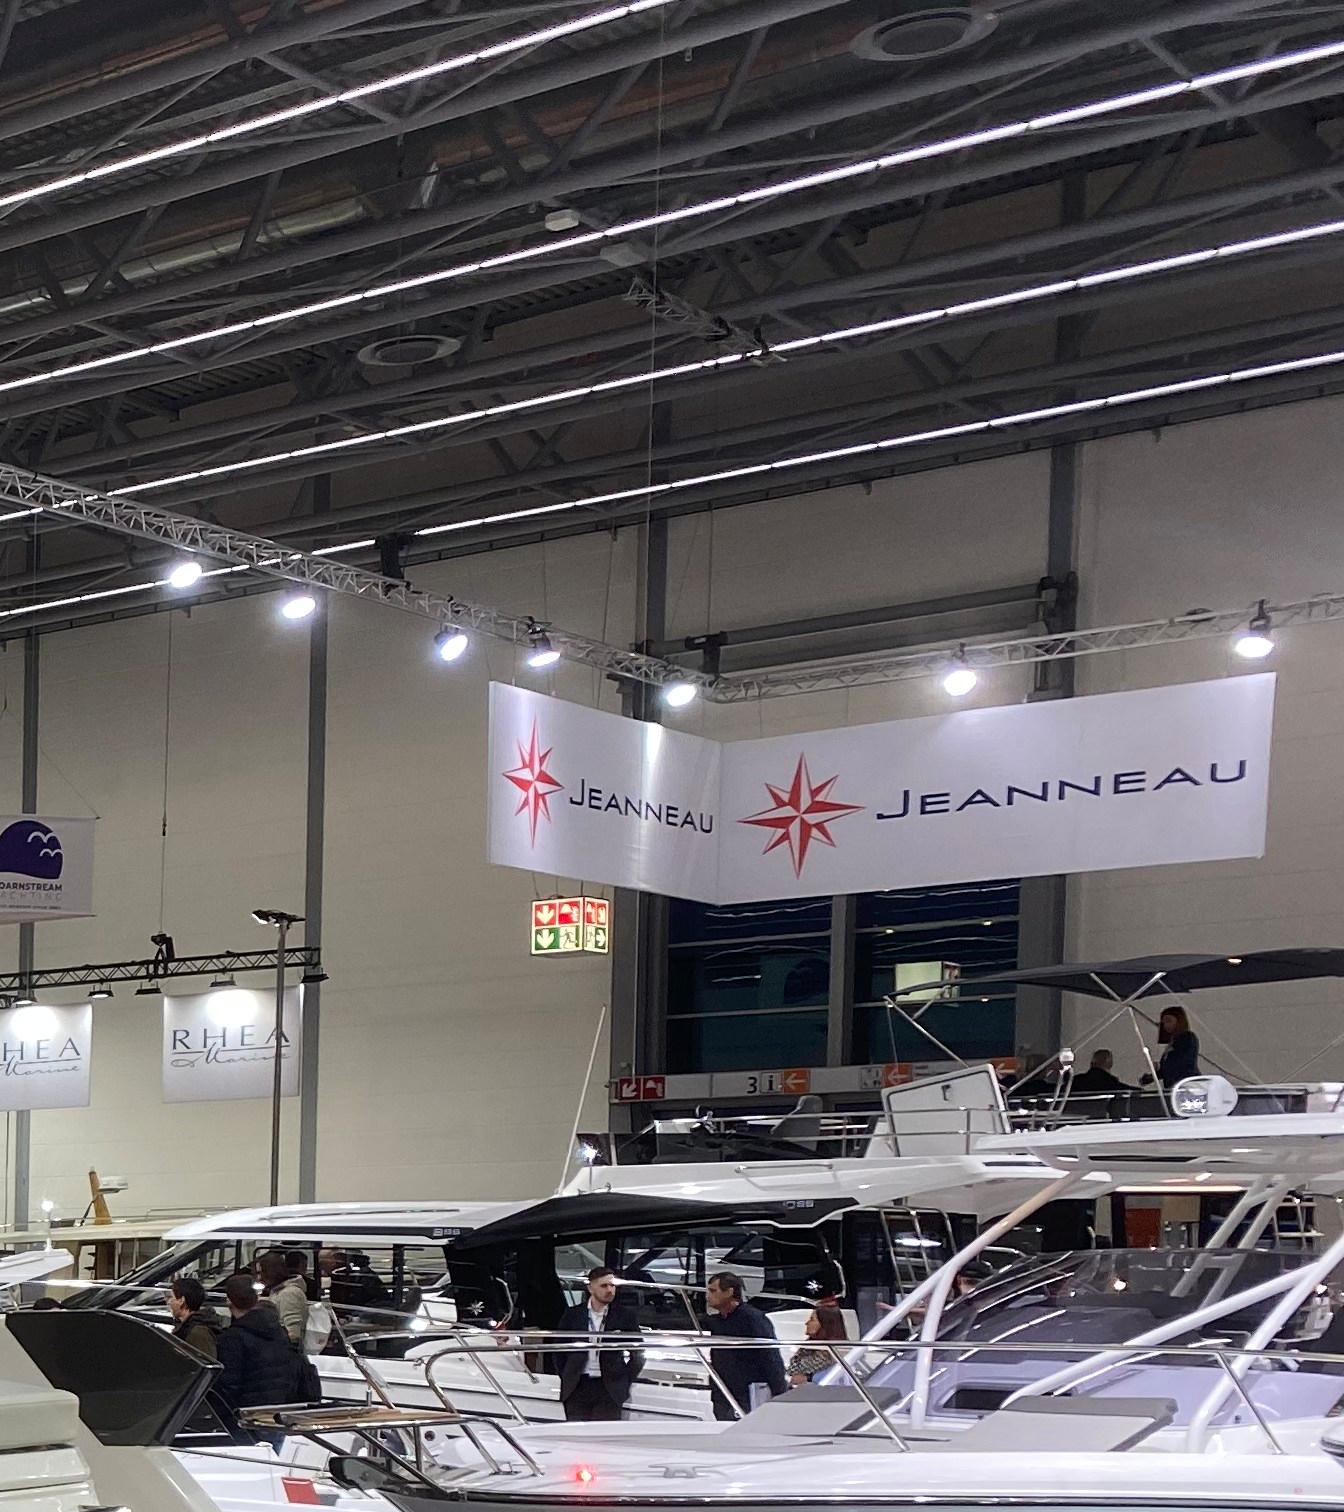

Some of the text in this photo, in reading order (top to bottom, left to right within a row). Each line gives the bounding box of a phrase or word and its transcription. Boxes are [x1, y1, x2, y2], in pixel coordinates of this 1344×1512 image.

[569, 778, 714, 834] JEANNEAU
[876, 759, 1247, 821] JEANNEAU
[172, 1024, 290, 1050] RHEA
[746, 1076, 758, 1094] 3
